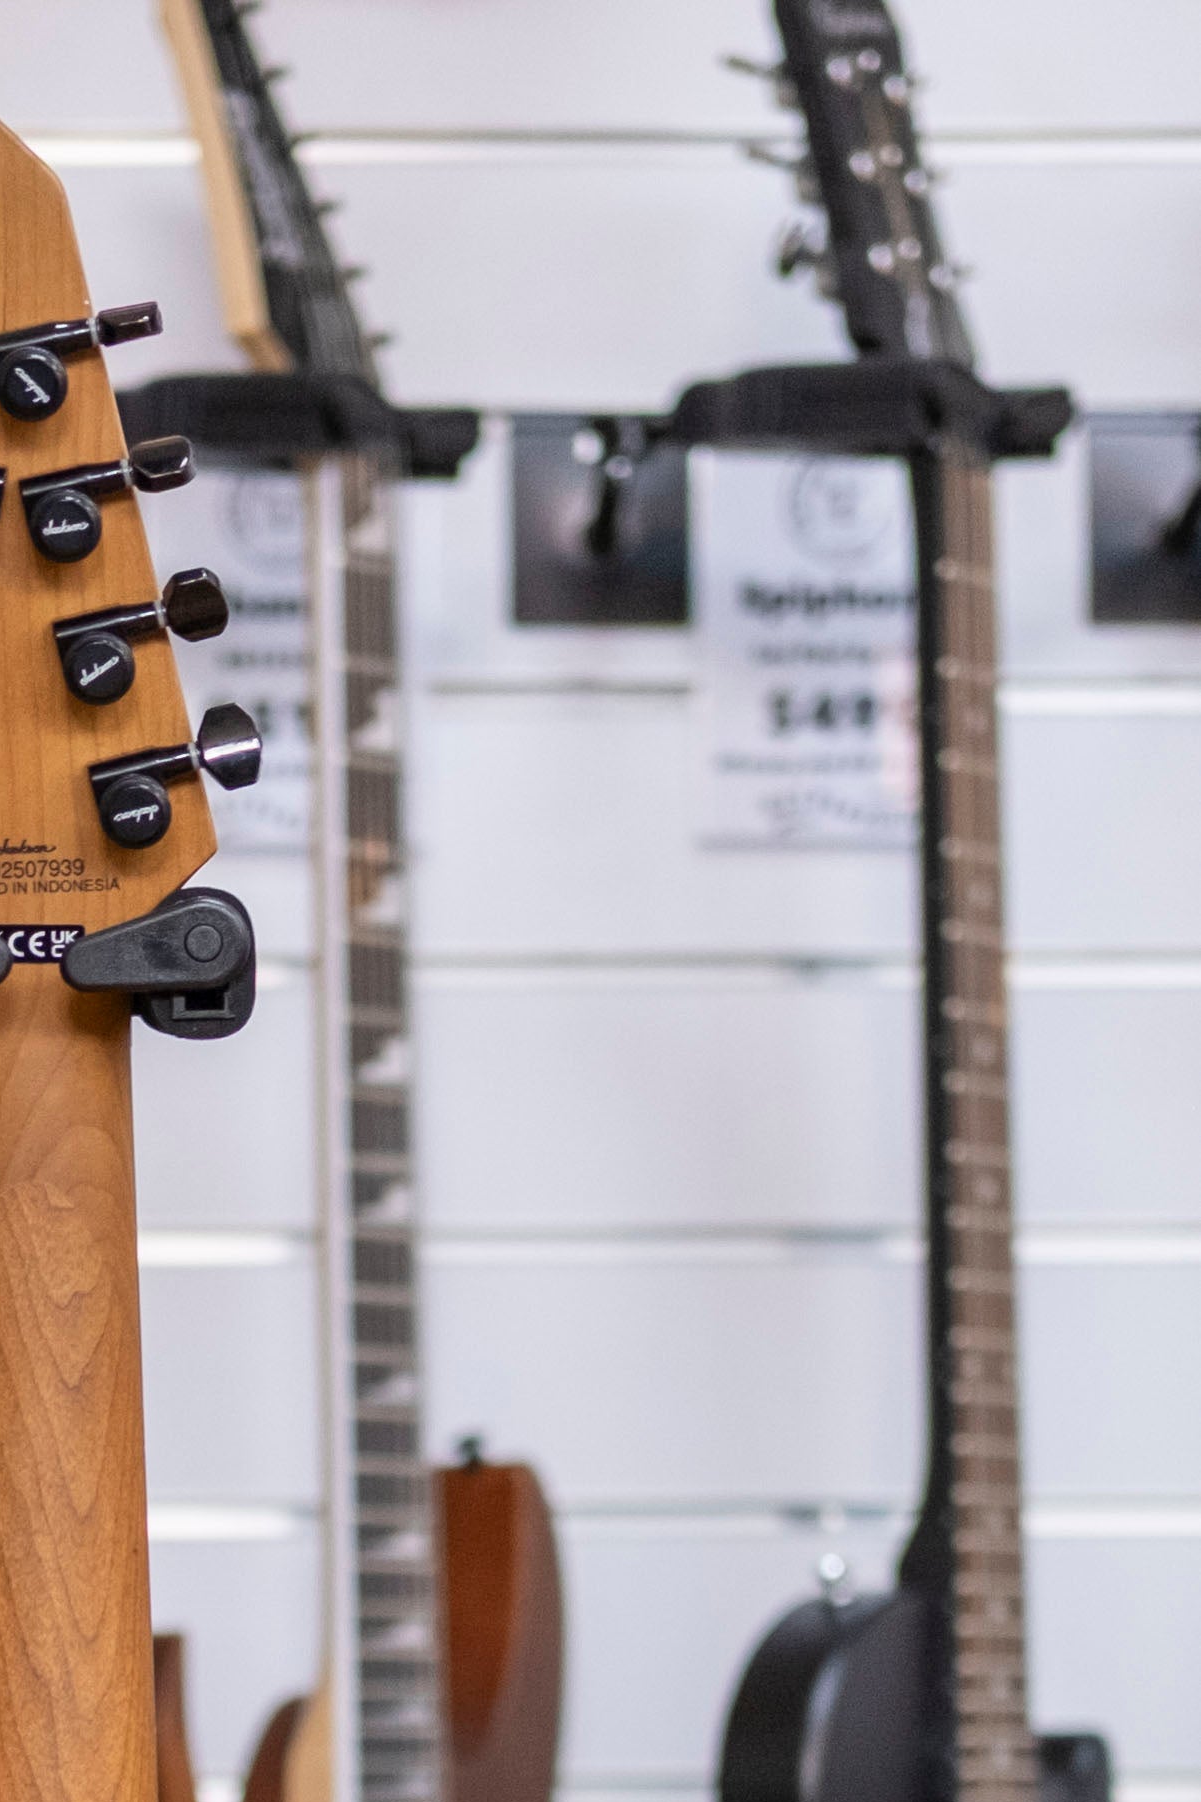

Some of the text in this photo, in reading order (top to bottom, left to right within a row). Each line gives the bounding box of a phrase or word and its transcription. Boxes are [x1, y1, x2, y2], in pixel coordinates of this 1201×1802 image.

[12, 881, 28, 895] IN
[33, 876, 121, 894] INDONESIA
[7, 930, 46, 958] CE
